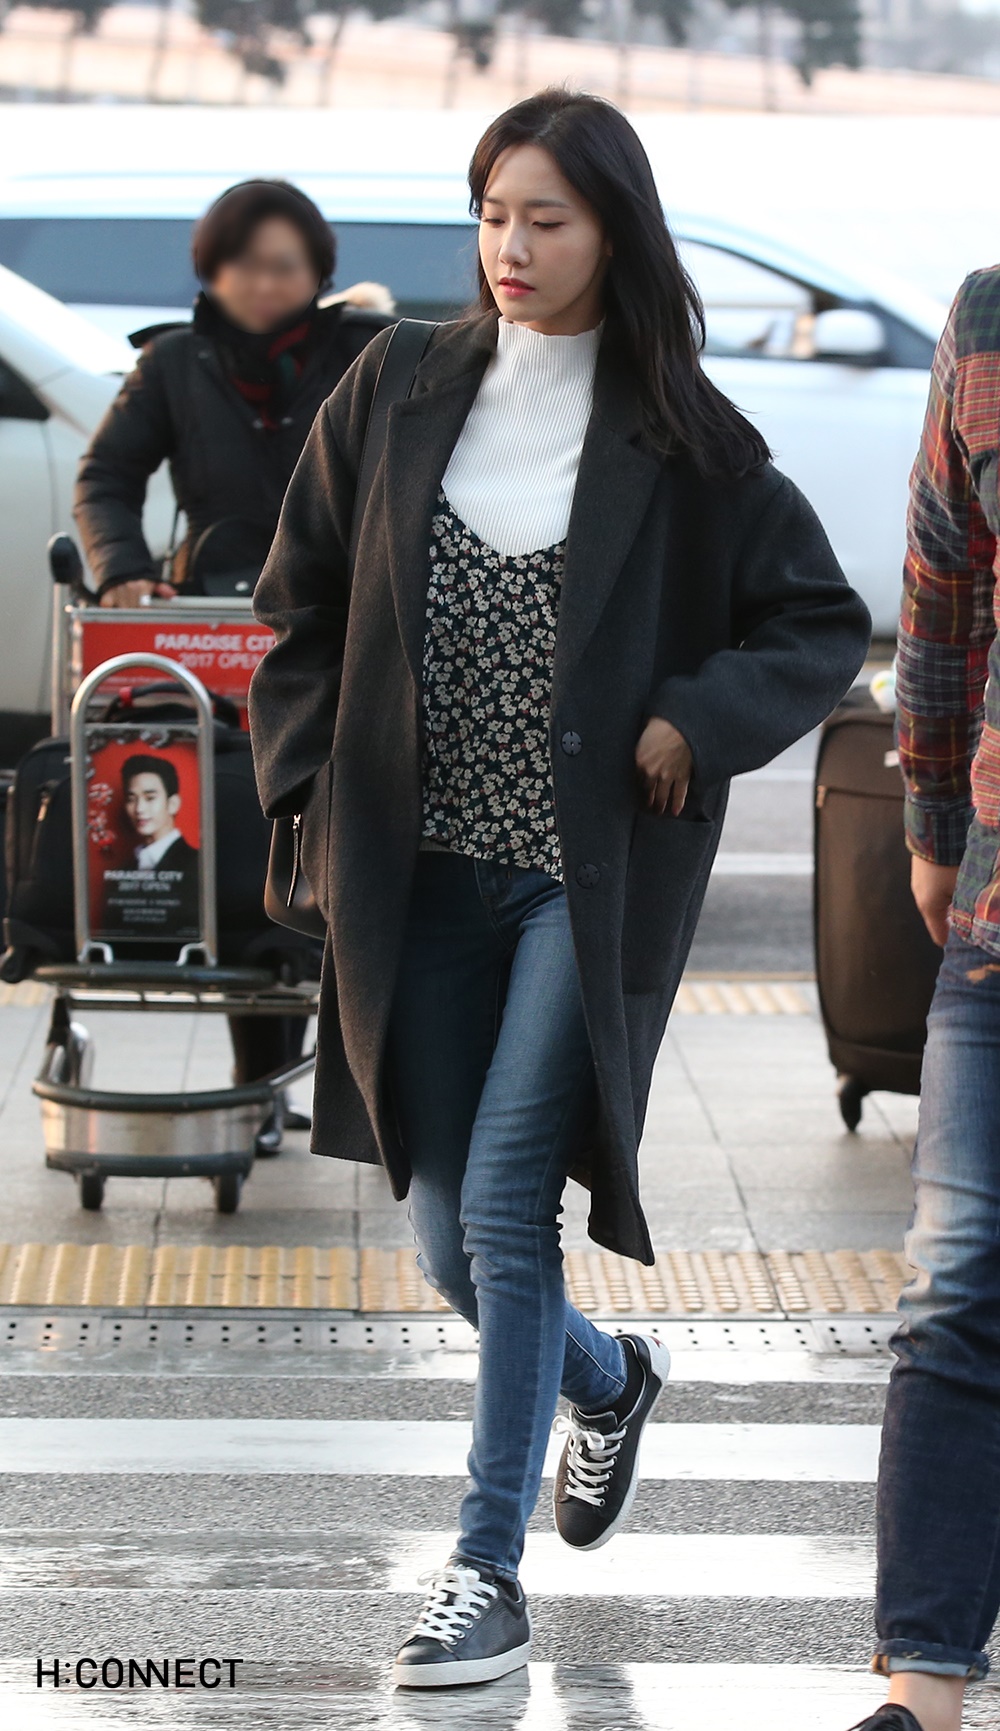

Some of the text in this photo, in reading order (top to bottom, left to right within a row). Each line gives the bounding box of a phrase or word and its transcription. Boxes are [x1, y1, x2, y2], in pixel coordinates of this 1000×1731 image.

[154, 633, 276, 651] PARADISE CIT
[178, 652, 215, 668] 2017
[103, 869, 183, 882] PARADISE CITY
